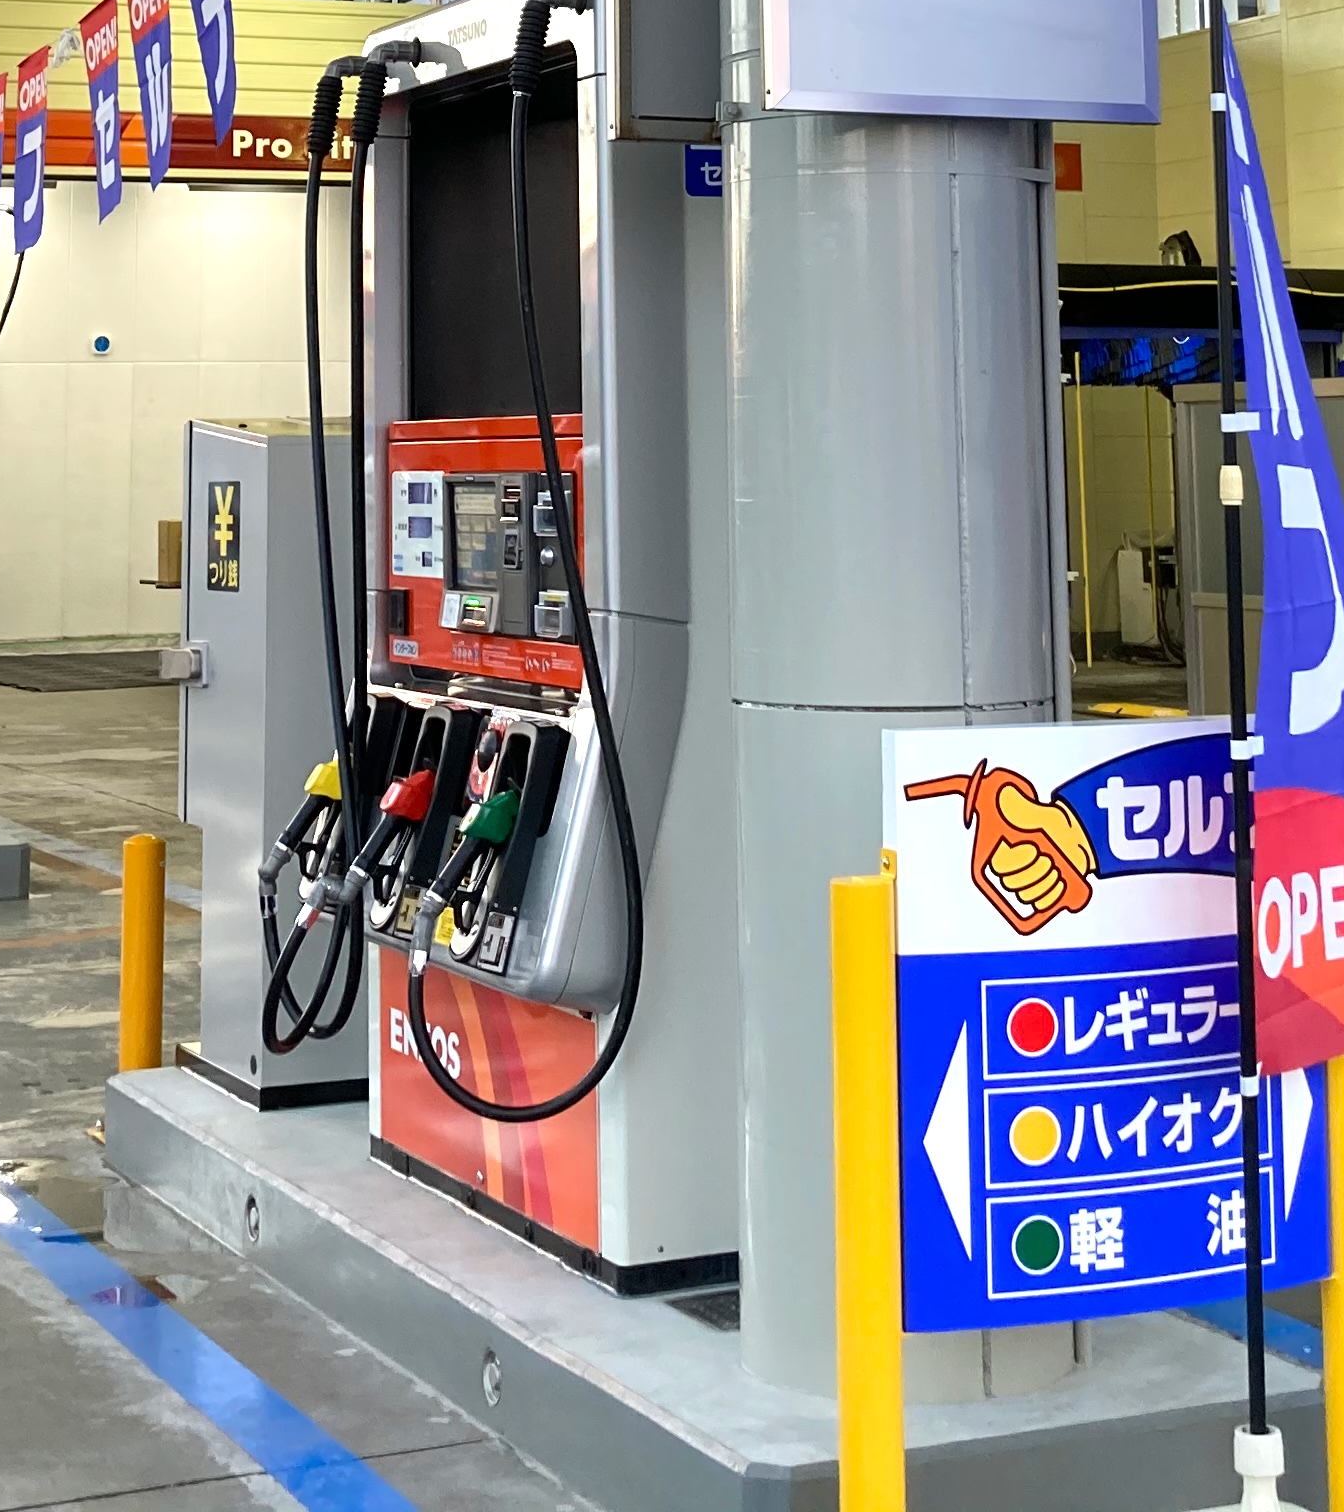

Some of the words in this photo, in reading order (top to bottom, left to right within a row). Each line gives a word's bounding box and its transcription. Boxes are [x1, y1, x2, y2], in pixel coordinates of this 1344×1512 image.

[86, 15, 117, 71] OPEN!
[447, 19, 487, 47] TATSUNO
[95, 89, 115, 189] セ
[233, 129, 292, 159] Pro
[308, 130, 354, 159] it
[390, 1007, 460, 1079] ENOS
[1066, 1086, 1246, 1164] ハイオク
[1069, 1190, 1247, 1275] 軽油
